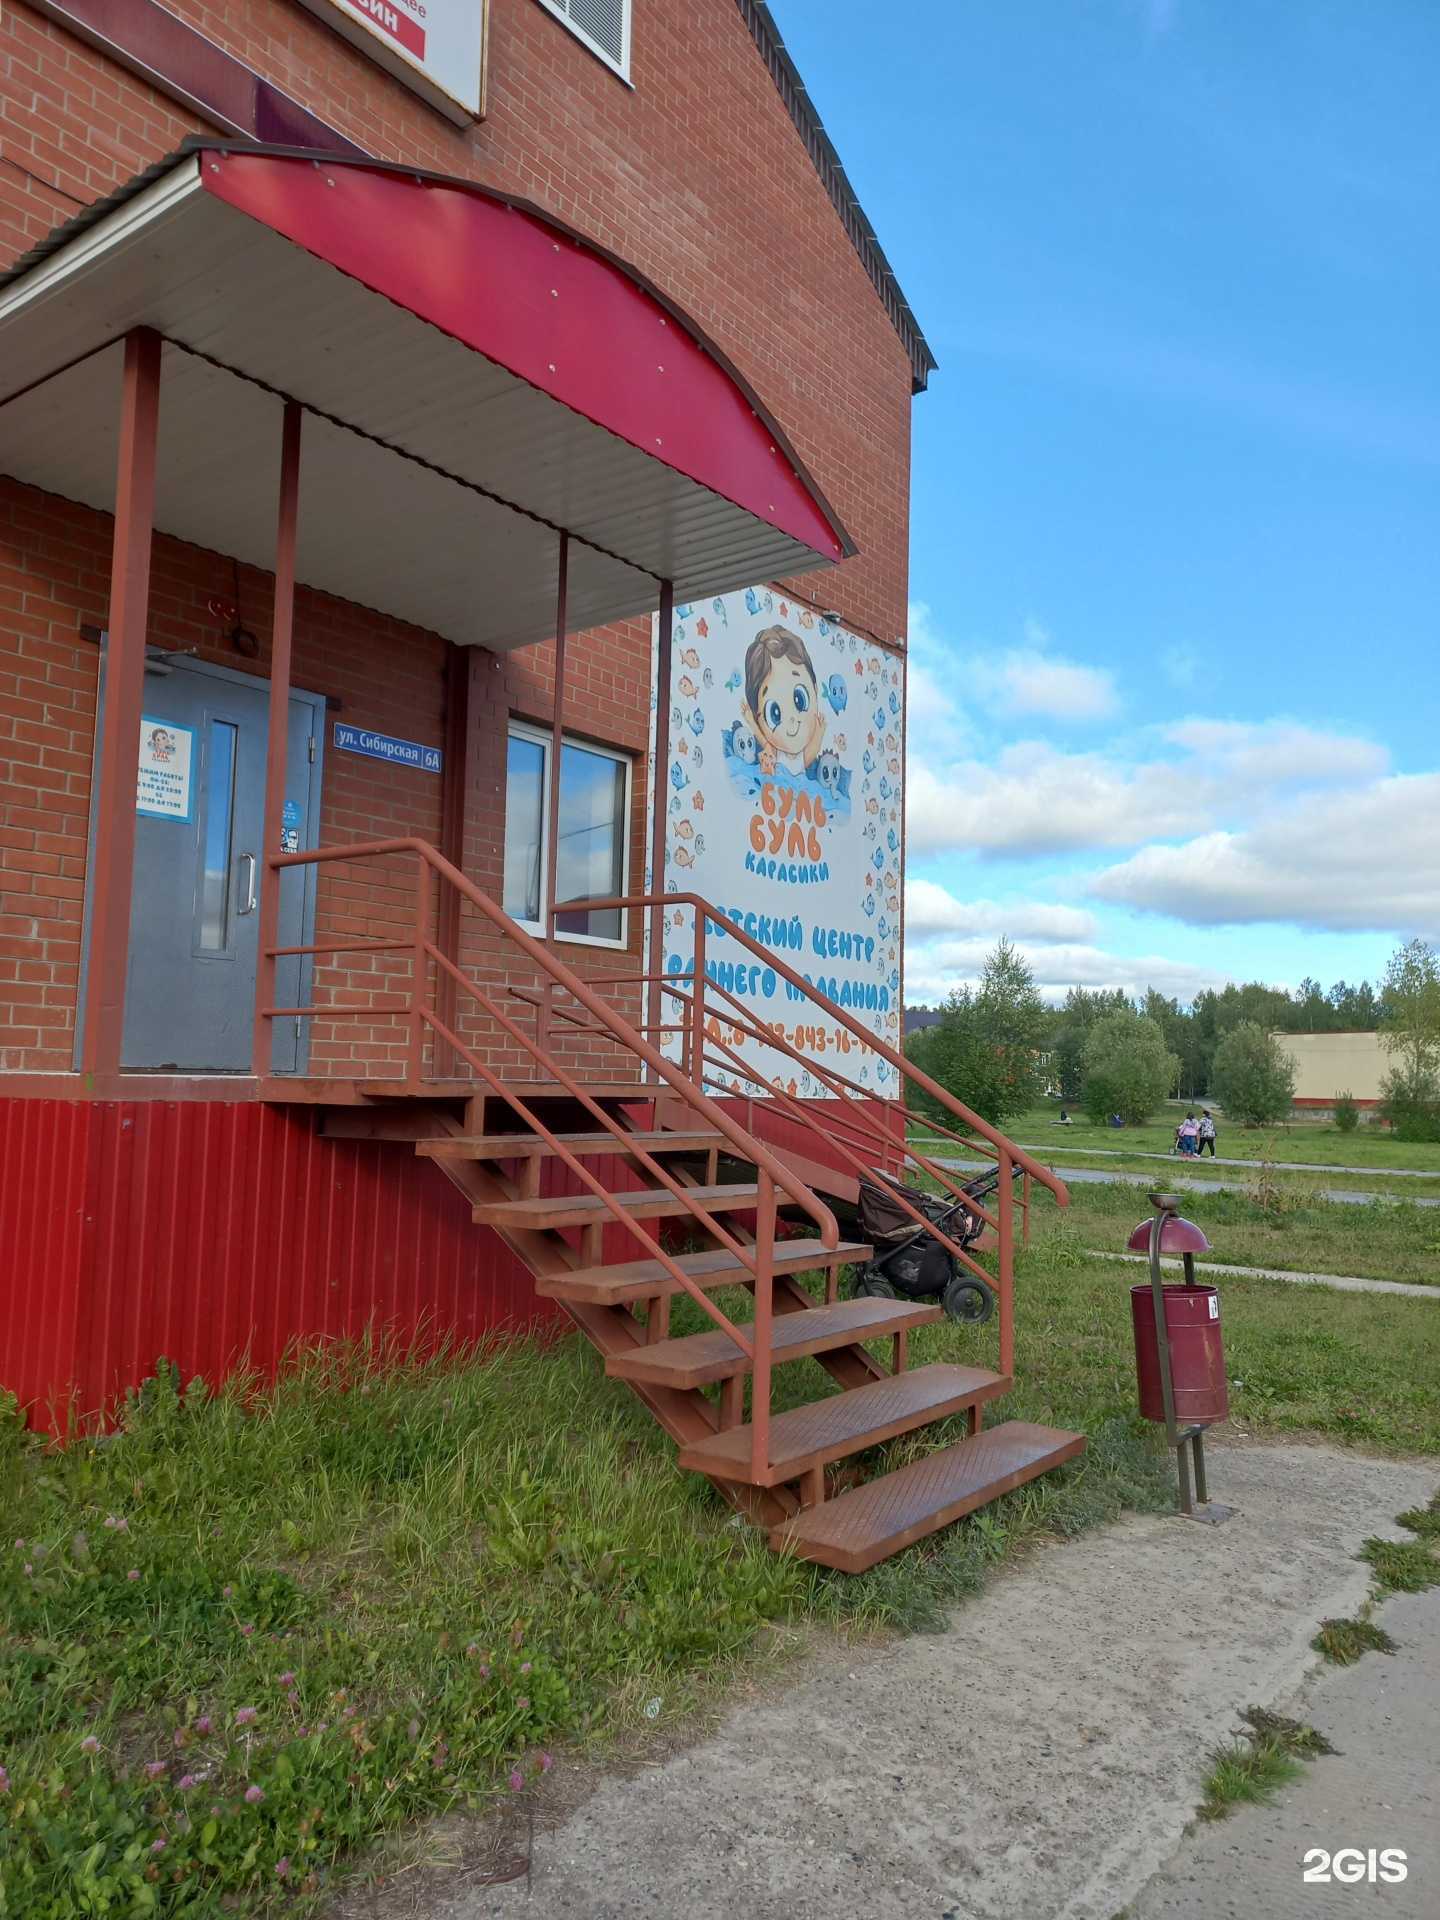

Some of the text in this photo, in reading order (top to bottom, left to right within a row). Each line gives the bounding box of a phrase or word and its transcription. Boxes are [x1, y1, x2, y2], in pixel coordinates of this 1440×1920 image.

[339, 730, 440, 769] ул. Сибирская 6А
[761, 782, 827, 828] БУЛЬ
[749, 814, 822, 862] БУЛЬ
[745, 851, 829, 884] КАРАСИКИ
[812, 926, 875, 963] ЦЕНТР
